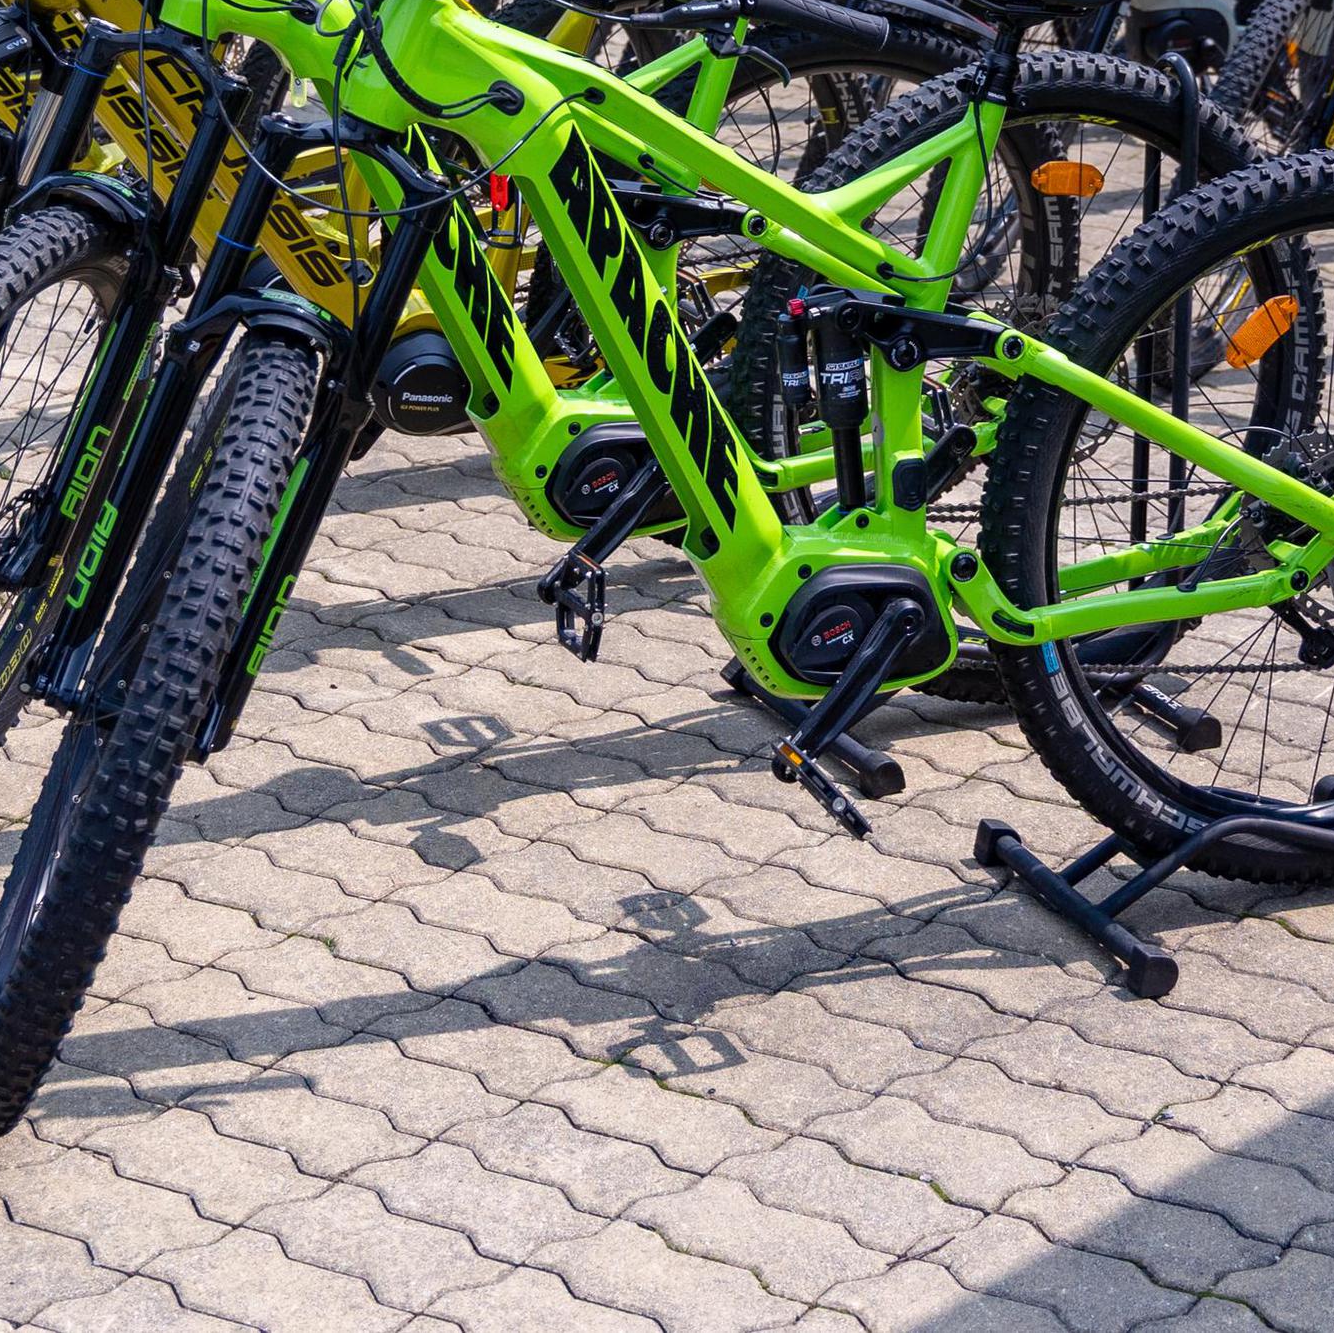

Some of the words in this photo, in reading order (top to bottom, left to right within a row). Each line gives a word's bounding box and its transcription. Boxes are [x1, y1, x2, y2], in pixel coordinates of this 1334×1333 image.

[548, 123, 740, 534] APACHE
[402, 392, 453, 403] Panasonic
[60, 424, 113, 520] AION
[67, 498, 119, 610] AION
[822, 619, 852, 641] BOSCH
